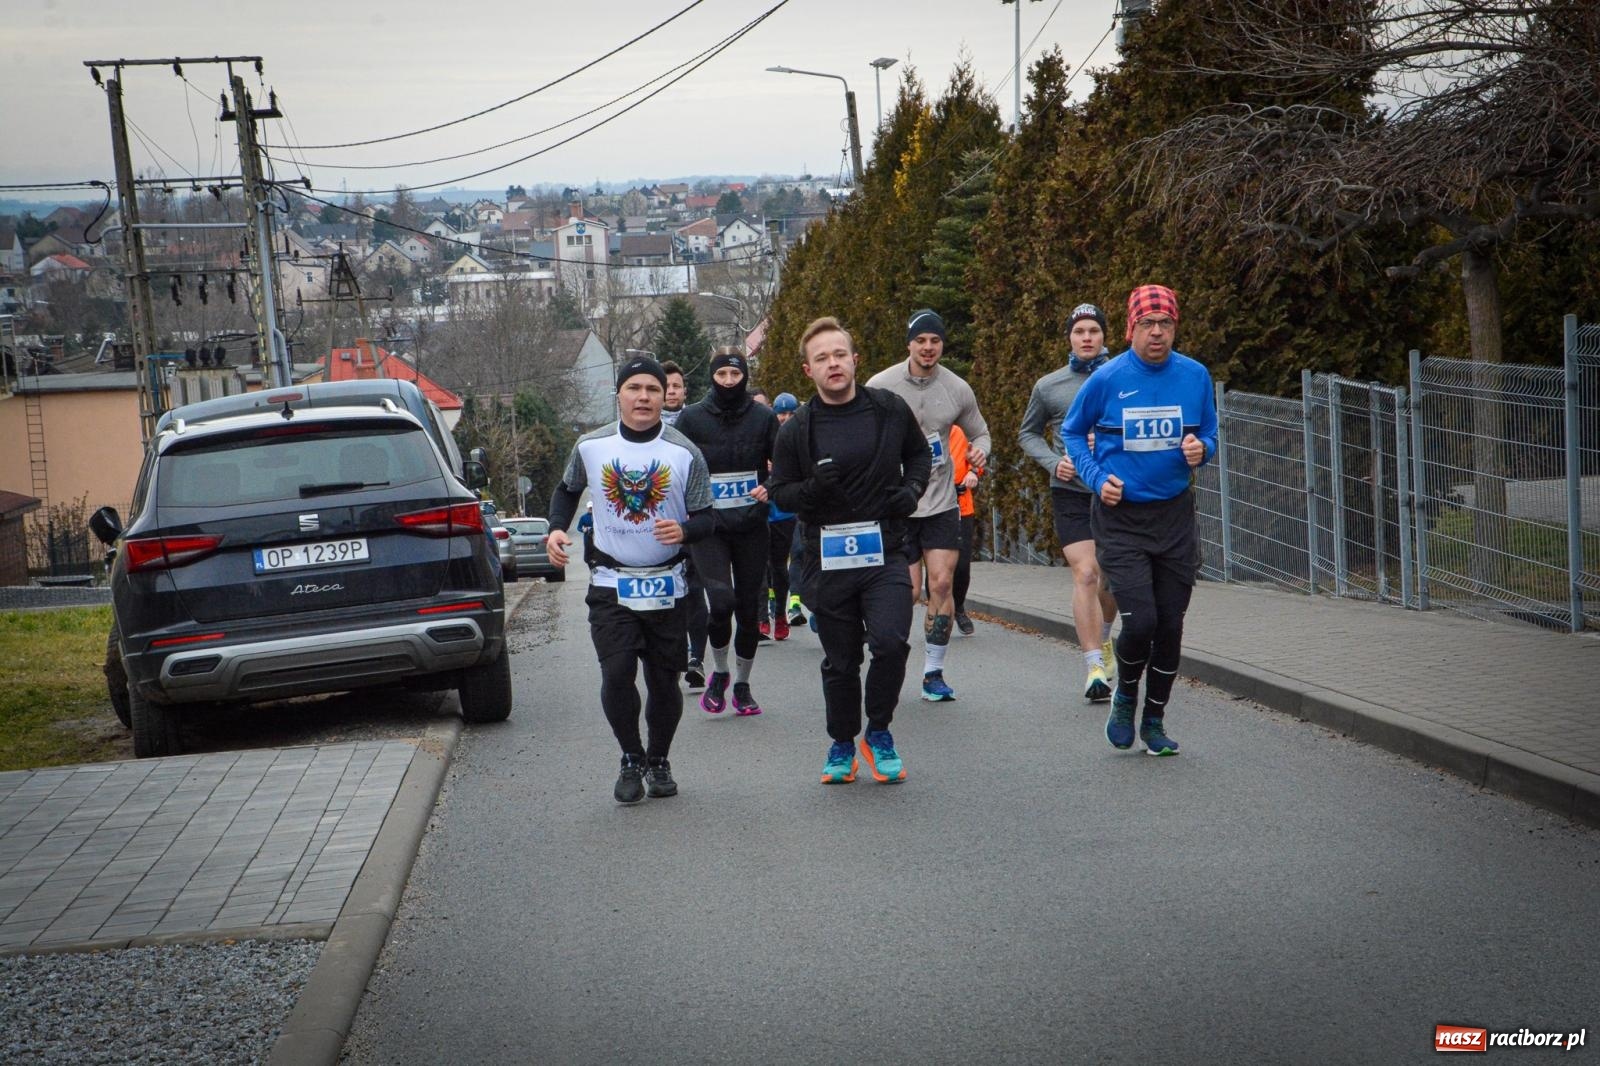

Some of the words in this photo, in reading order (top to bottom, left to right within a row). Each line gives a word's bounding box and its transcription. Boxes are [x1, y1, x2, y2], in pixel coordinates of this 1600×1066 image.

[1135, 418, 1173, 438] 110
[718, 481, 752, 498] 211
[268, 549, 293, 567] OP
[303, 541, 362, 563] 1239P
[845, 536, 858, 555] 8
[290, 583, 344, 595] Ateca
[628, 578, 667, 597] 102
